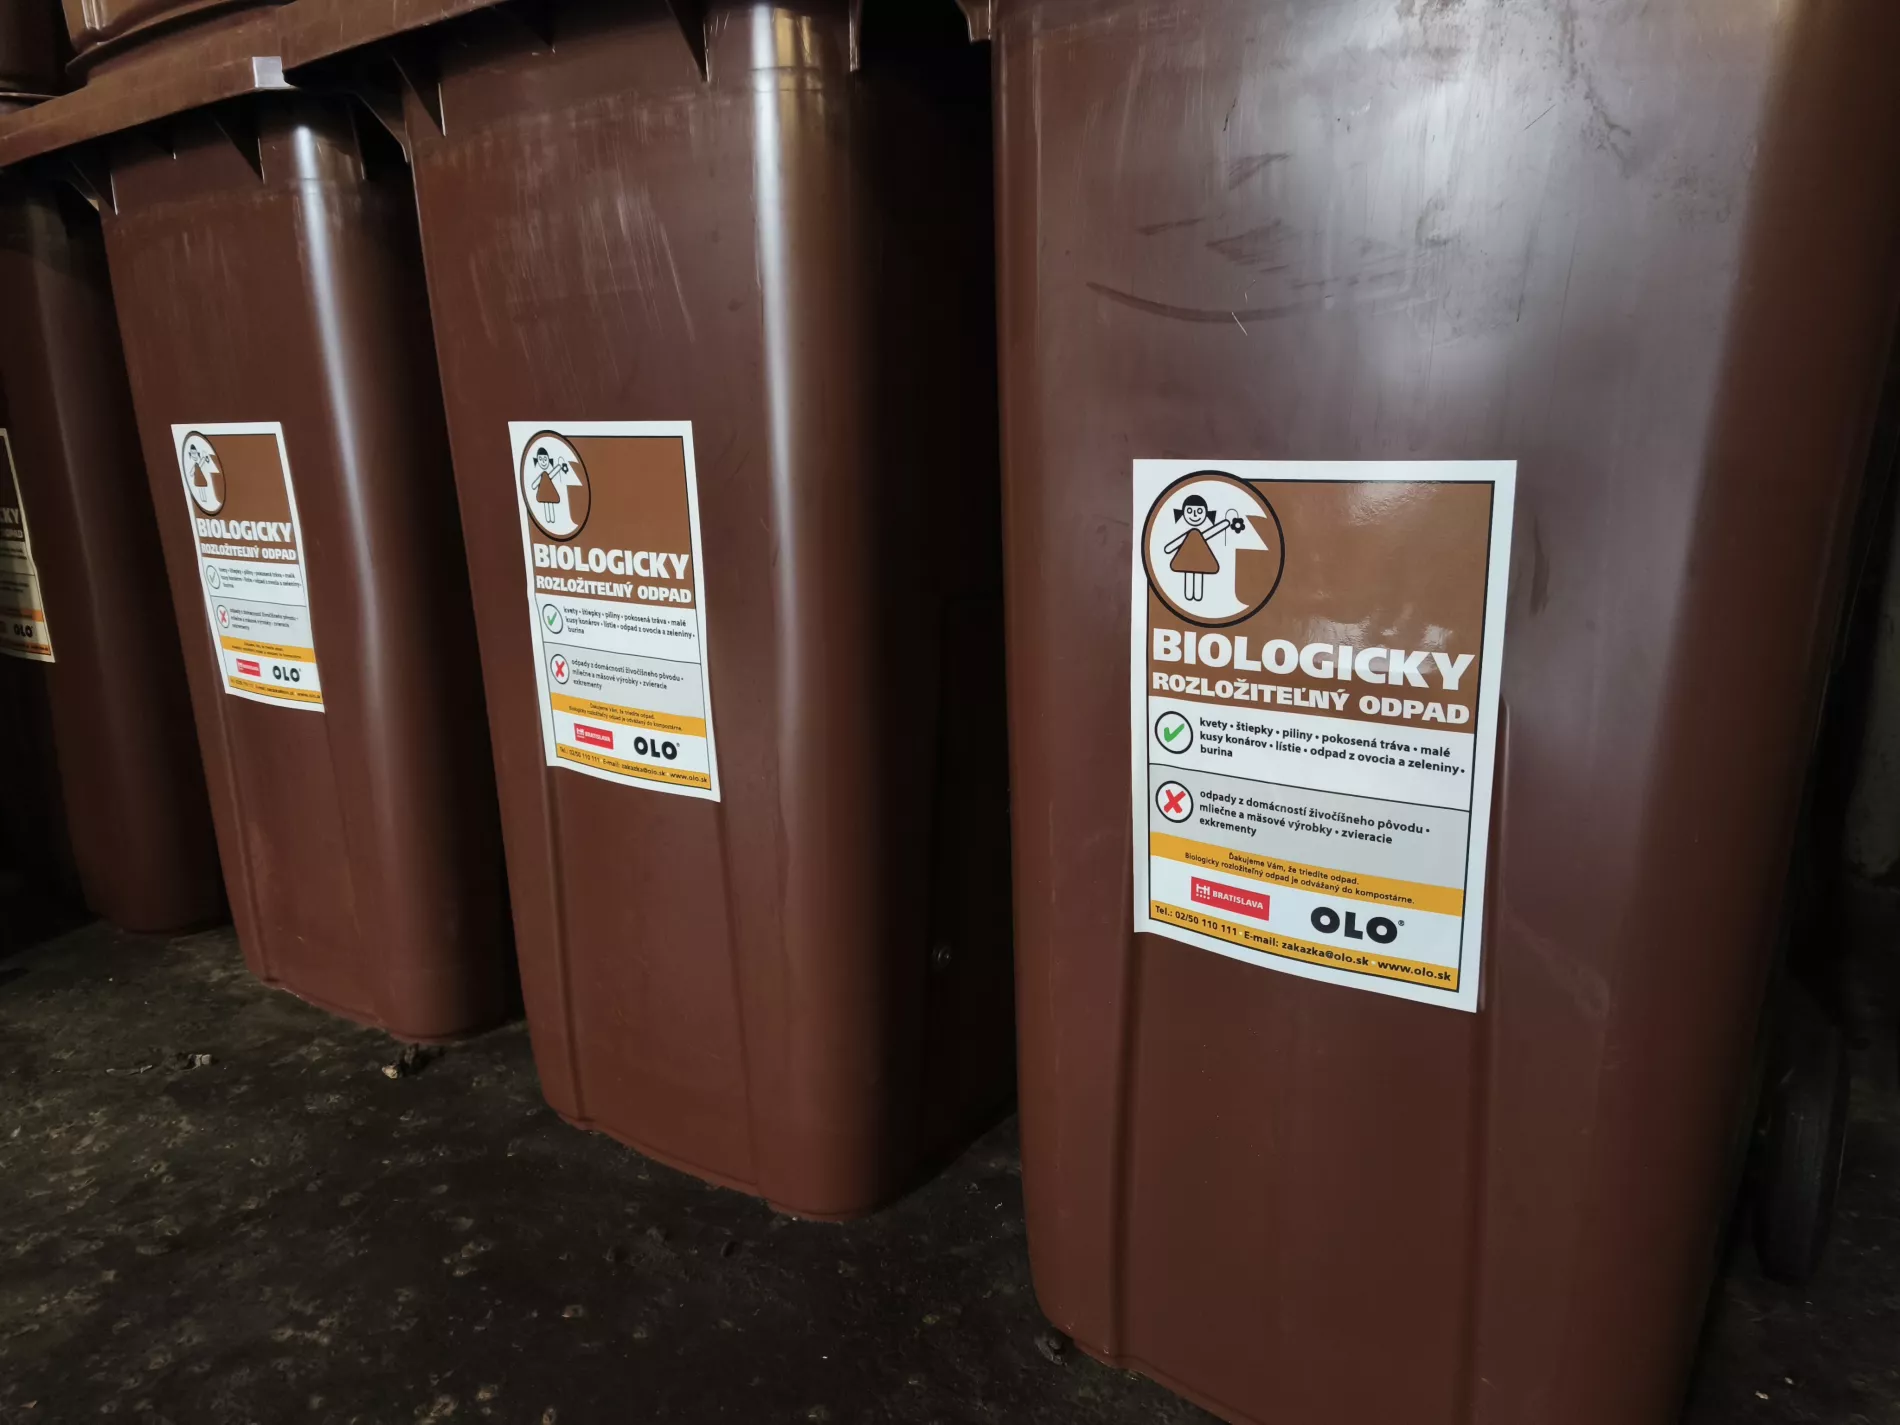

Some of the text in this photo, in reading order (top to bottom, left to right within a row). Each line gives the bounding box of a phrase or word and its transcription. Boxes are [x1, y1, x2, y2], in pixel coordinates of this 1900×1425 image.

[196, 518, 292, 542] BIOLOGICKY
[262, 548, 296, 560] ODPAD
[533, 543, 690, 580] BIOLOGICKY
[536, 576, 692, 603] ROZLOŽITEĽNÝ ODPAD
[1153, 628, 1475, 690] BIOLOGICKY
[1152, 672, 1470, 724] ROZLOŽITEĽNÝ ODPAD
[1200, 717, 1450, 757] kvety štiepky piliny pokosená tráva malé
[1200, 744, 1232, 757] burina
[1200, 731, 1459, 775] kusy konárov lístie odpad z ovocia a zeleniny
[1200, 790, 1236, 804] odpady
[1246, 798, 1306, 816] domácností
[1309, 808, 1374, 827] živočíšneho
[1378, 820, 1423, 834] pôvodu
[1200, 803, 1236, 817] mliečne
[1247, 813, 1285, 826] mäsové
[1288, 820, 1332, 836] výrobky
[1342, 830, 1392, 844] zvieracie
[1200, 817, 1256, 837] exkrementy
[1185, 852, 1414, 904] Biologicky rozložiteľný odpad je odvážaný do kompostárne.
[1229, 852, 1359, 885] Ďakujeme Vám, že triedite odpad.
[1212, 890, 1263, 910] BRATISLAVA
[1156, 905, 1451, 981] Tel.: 02/50 110 111 E-mail: zakazka@olo.sk www.olo.sk
